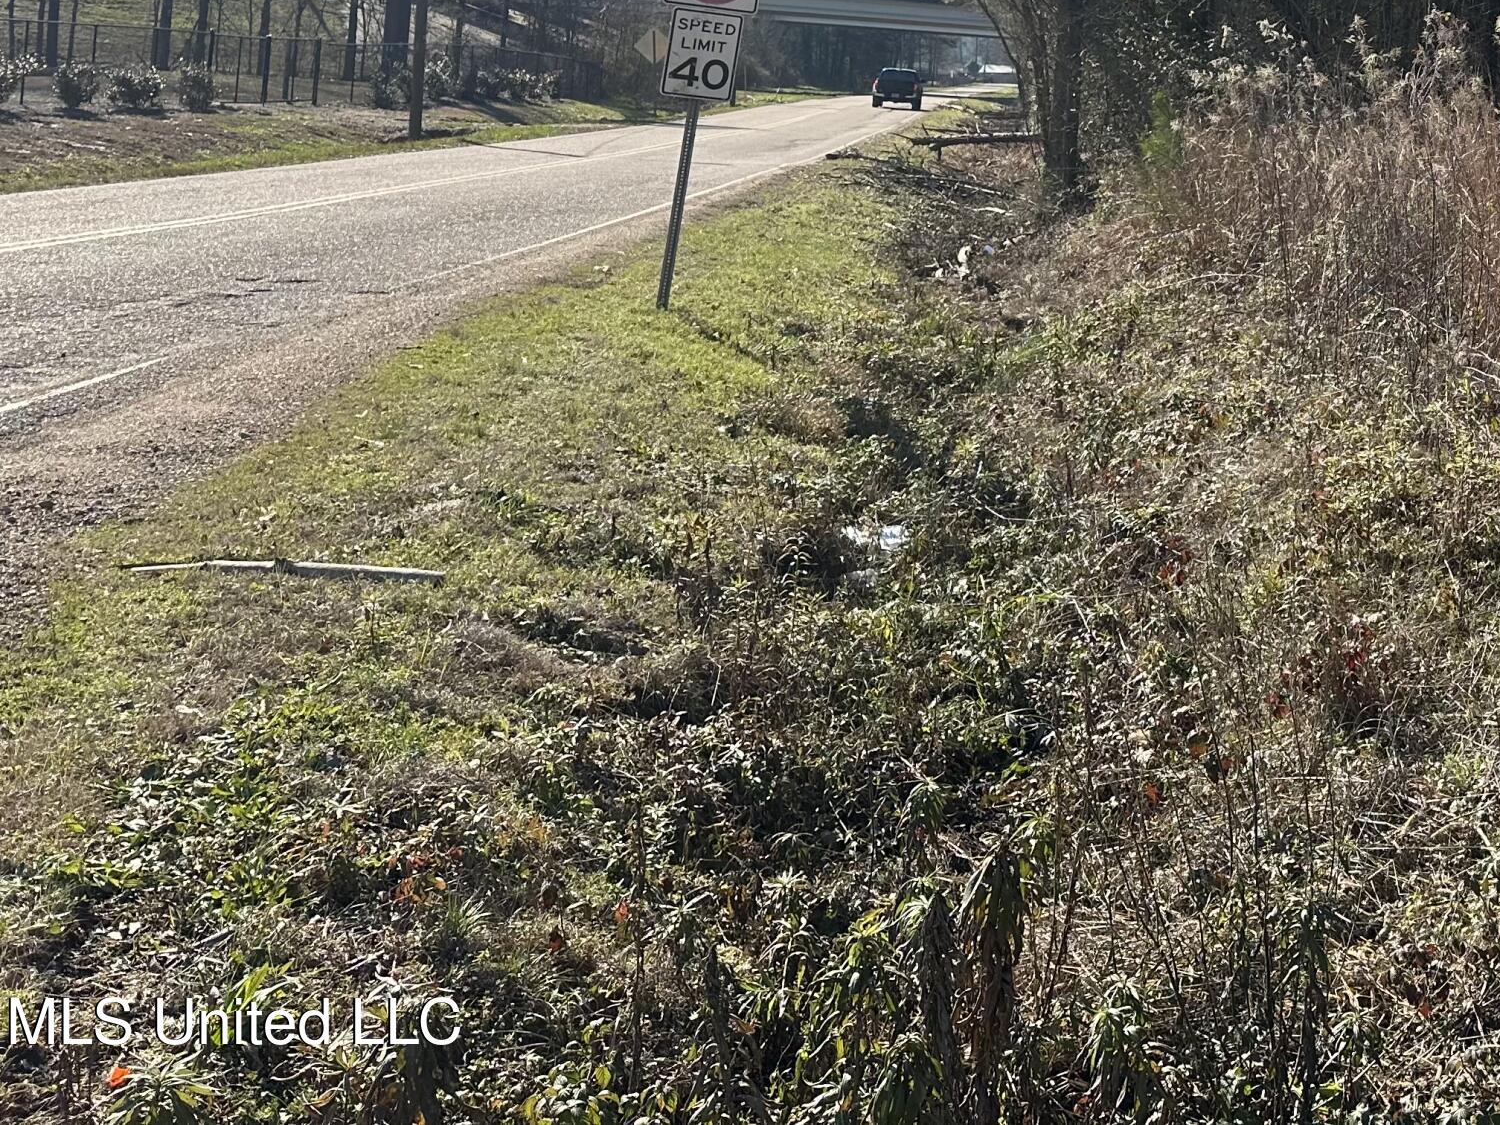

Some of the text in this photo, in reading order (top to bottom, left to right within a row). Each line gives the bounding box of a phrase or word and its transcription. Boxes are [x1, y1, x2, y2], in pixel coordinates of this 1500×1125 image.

[678, 18, 736, 35] SPEED
[681, 36, 727, 53] LIMIT
[668, 57, 729, 90] 40
